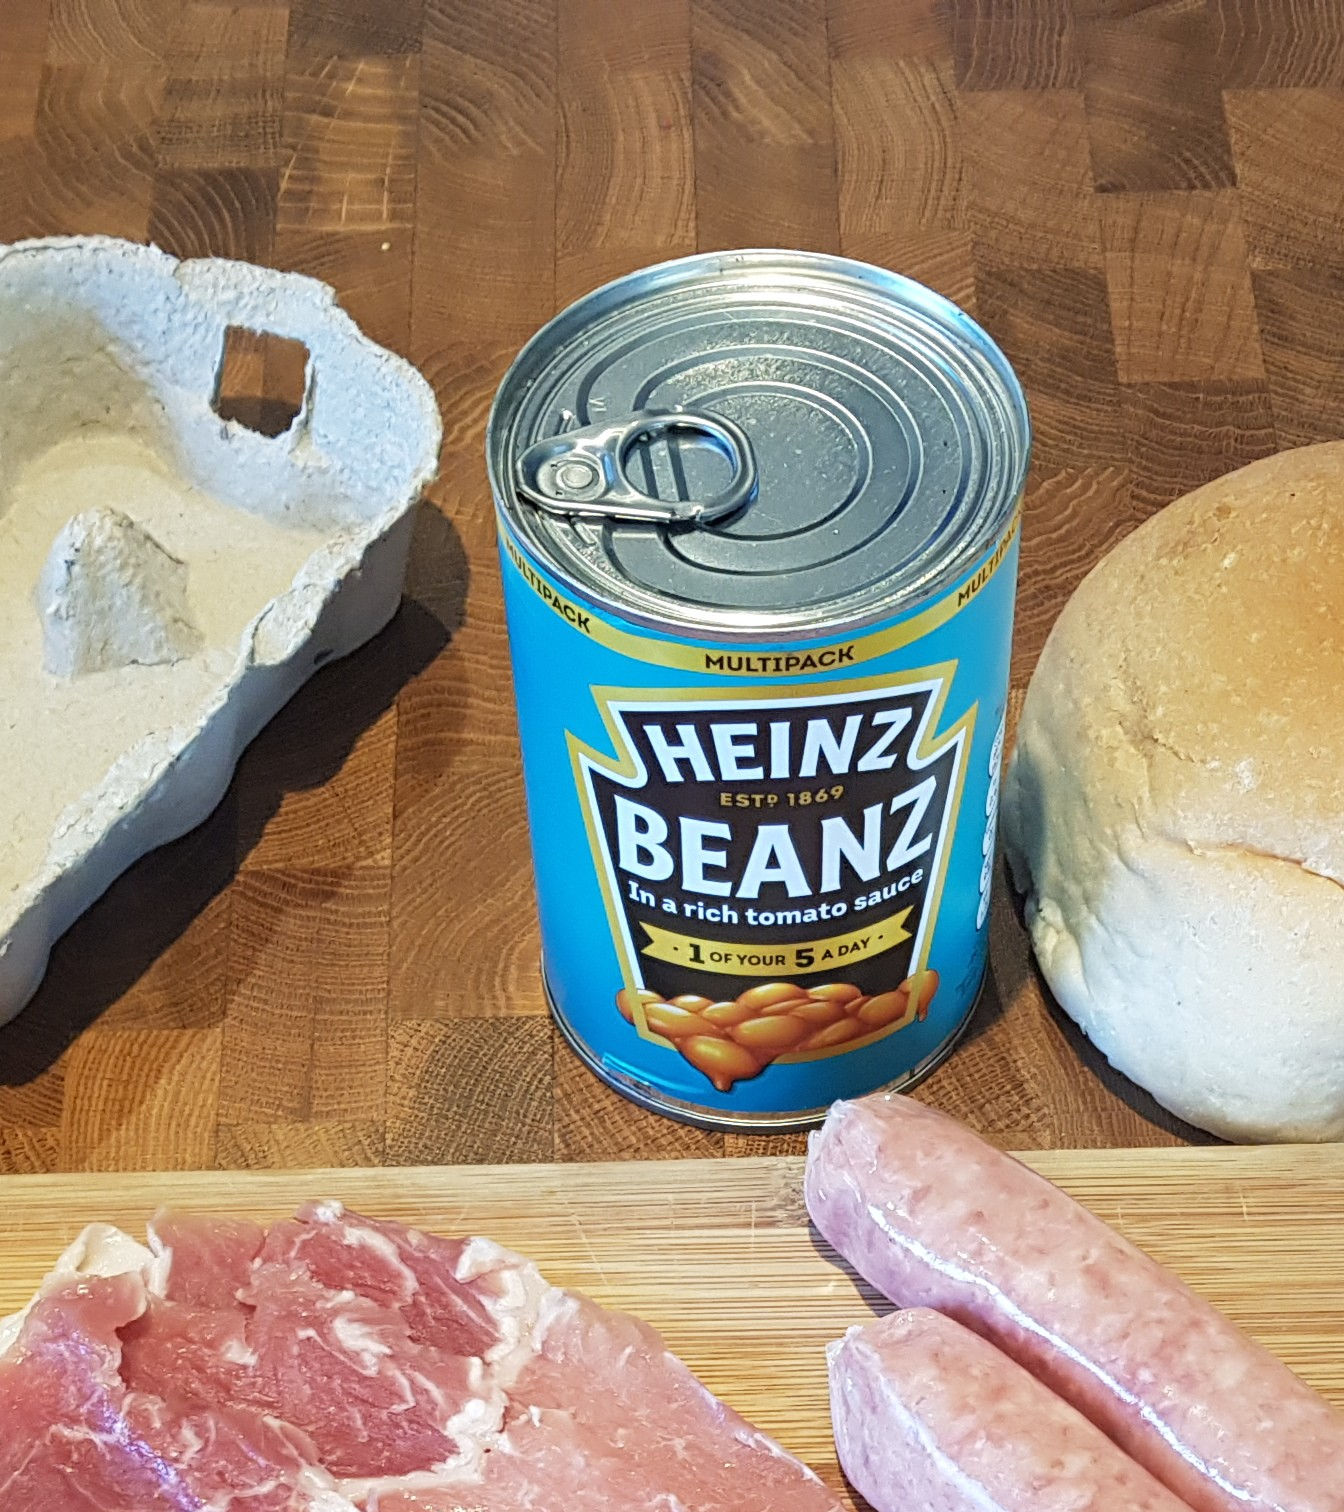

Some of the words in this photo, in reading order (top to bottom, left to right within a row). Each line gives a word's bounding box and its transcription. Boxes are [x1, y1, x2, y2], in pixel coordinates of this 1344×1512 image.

[505, 537, 591, 634] MULTIPACK
[705, 645, 855, 673] MULTIPACK
[642, 706, 913, 783] HEINZ
[786, 784, 845, 807] 1869
[613, 775, 938, 899] BEANZ
[628, 880, 656, 908] In
[662, 898, 678, 915] a
[684, 901, 739, 925] rich
[745, 901, 848, 927] tomato
[853, 867, 924, 912] sauce
[688, 943, 706, 965] 1
[709, 951, 733, 964] OF
[736, 954, 787, 967] YOUR
[794, 947, 815, 968] 5
[821, 949, 835, 961] A
[837, 936, 872, 958] DAY
